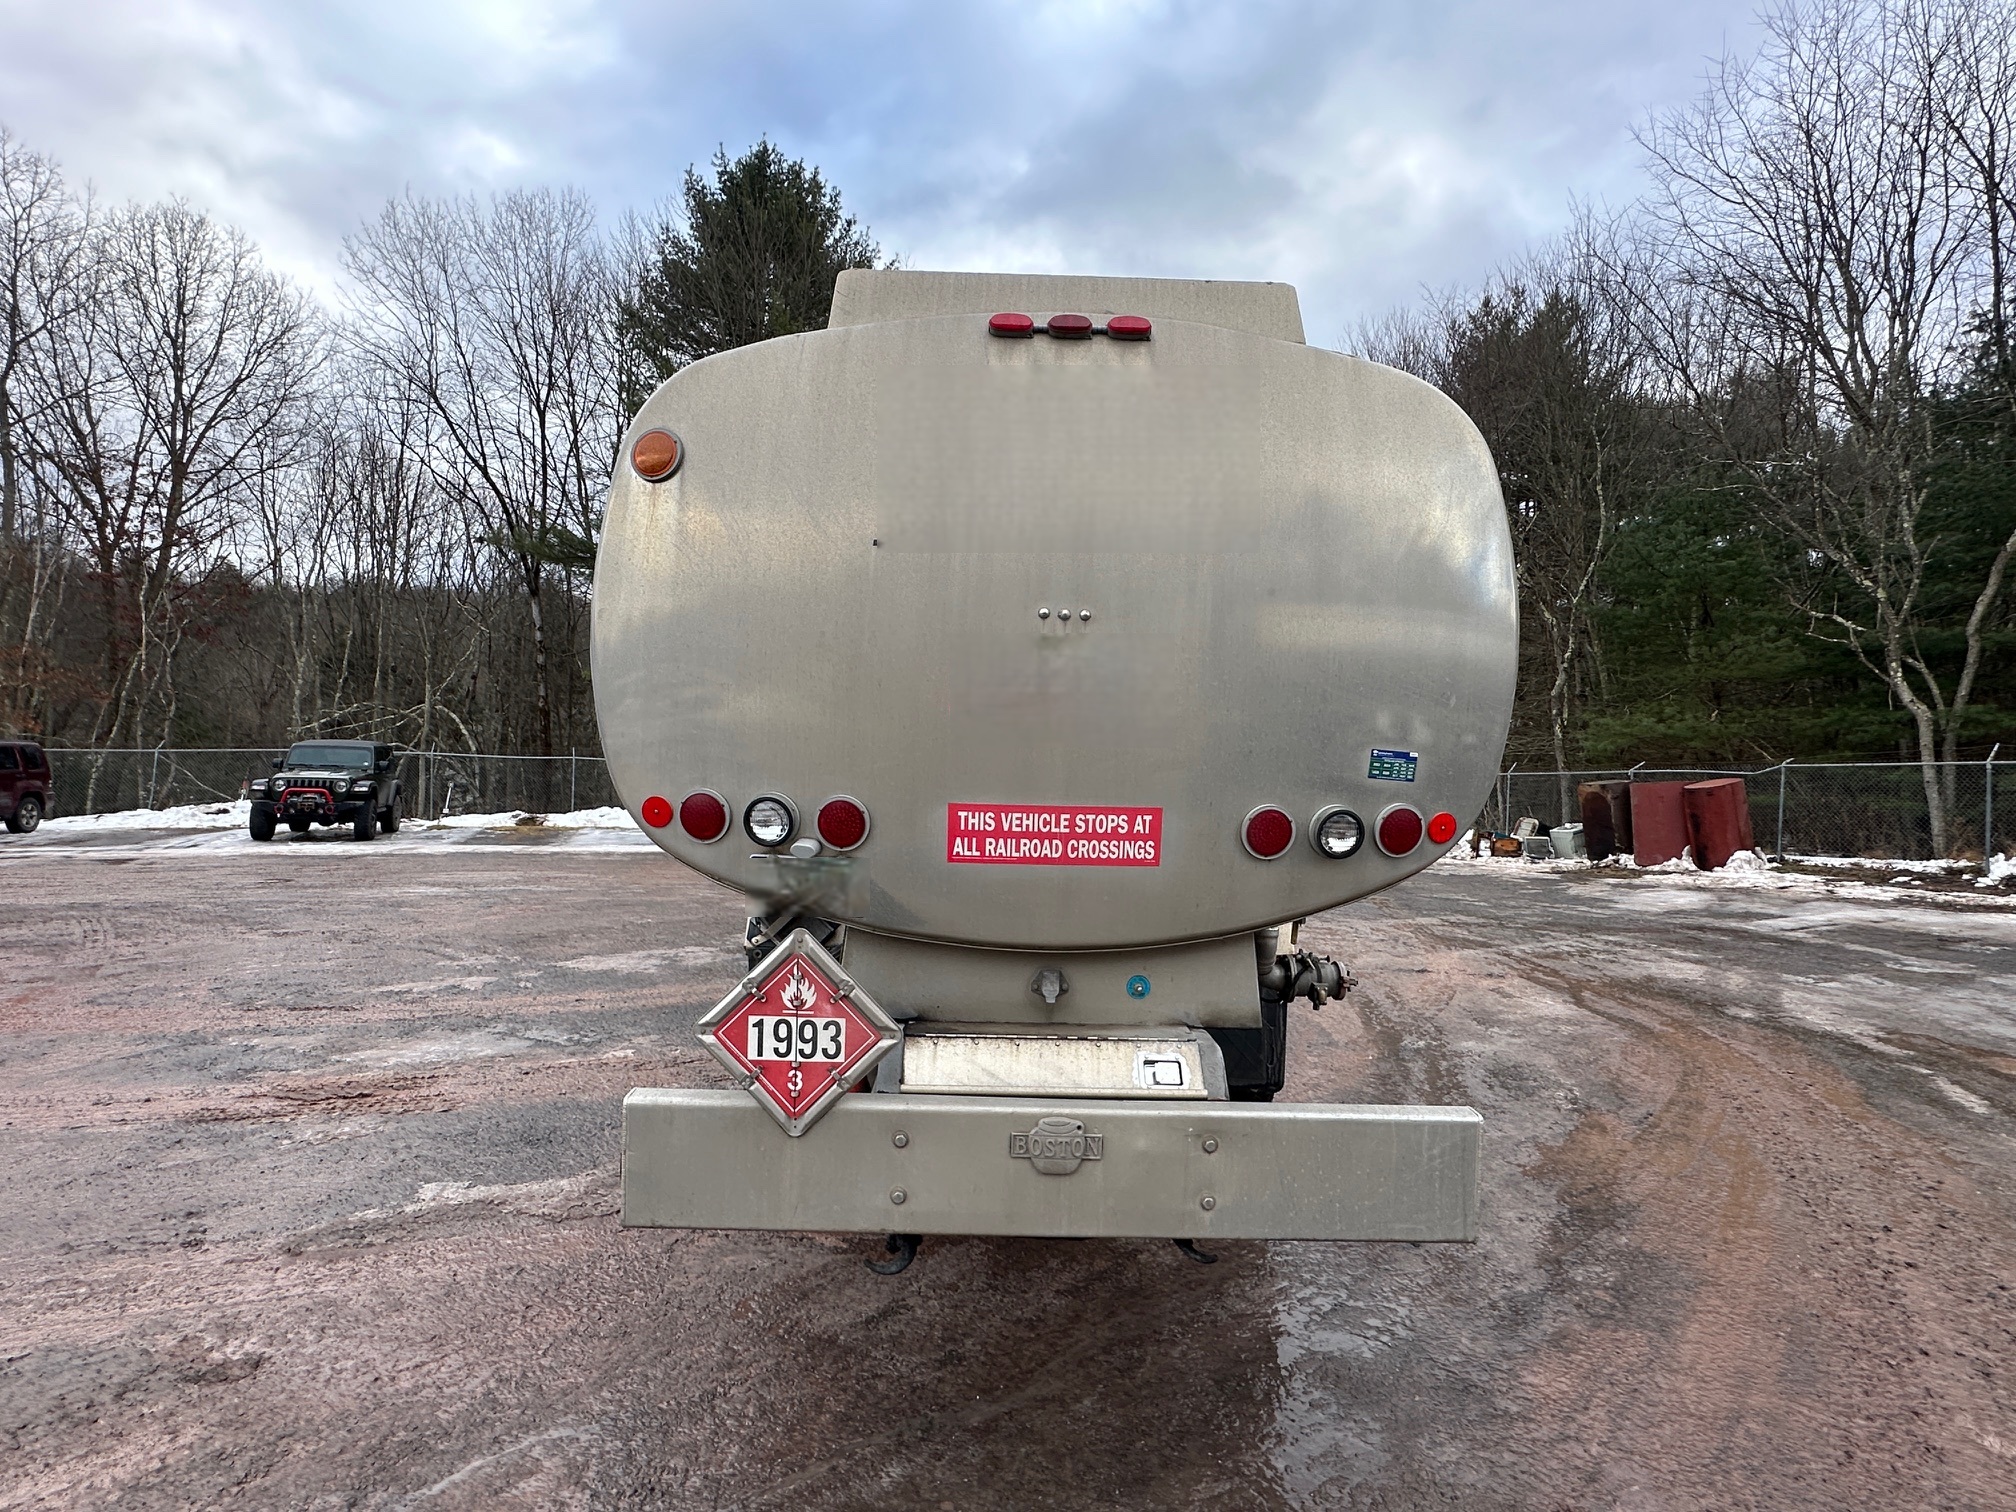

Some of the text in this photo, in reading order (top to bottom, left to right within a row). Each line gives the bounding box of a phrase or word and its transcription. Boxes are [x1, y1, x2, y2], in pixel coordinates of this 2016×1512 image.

[958, 811, 1153, 834] THIS VEHICLE STOPS AT
[952, 837, 1155, 860] ALL RAILROAD CROSSINGS
[752, 1018, 842, 1060] 1993
[787, 1070, 803, 1091] 3
[1013, 1135, 1102, 1158] BOSTON
